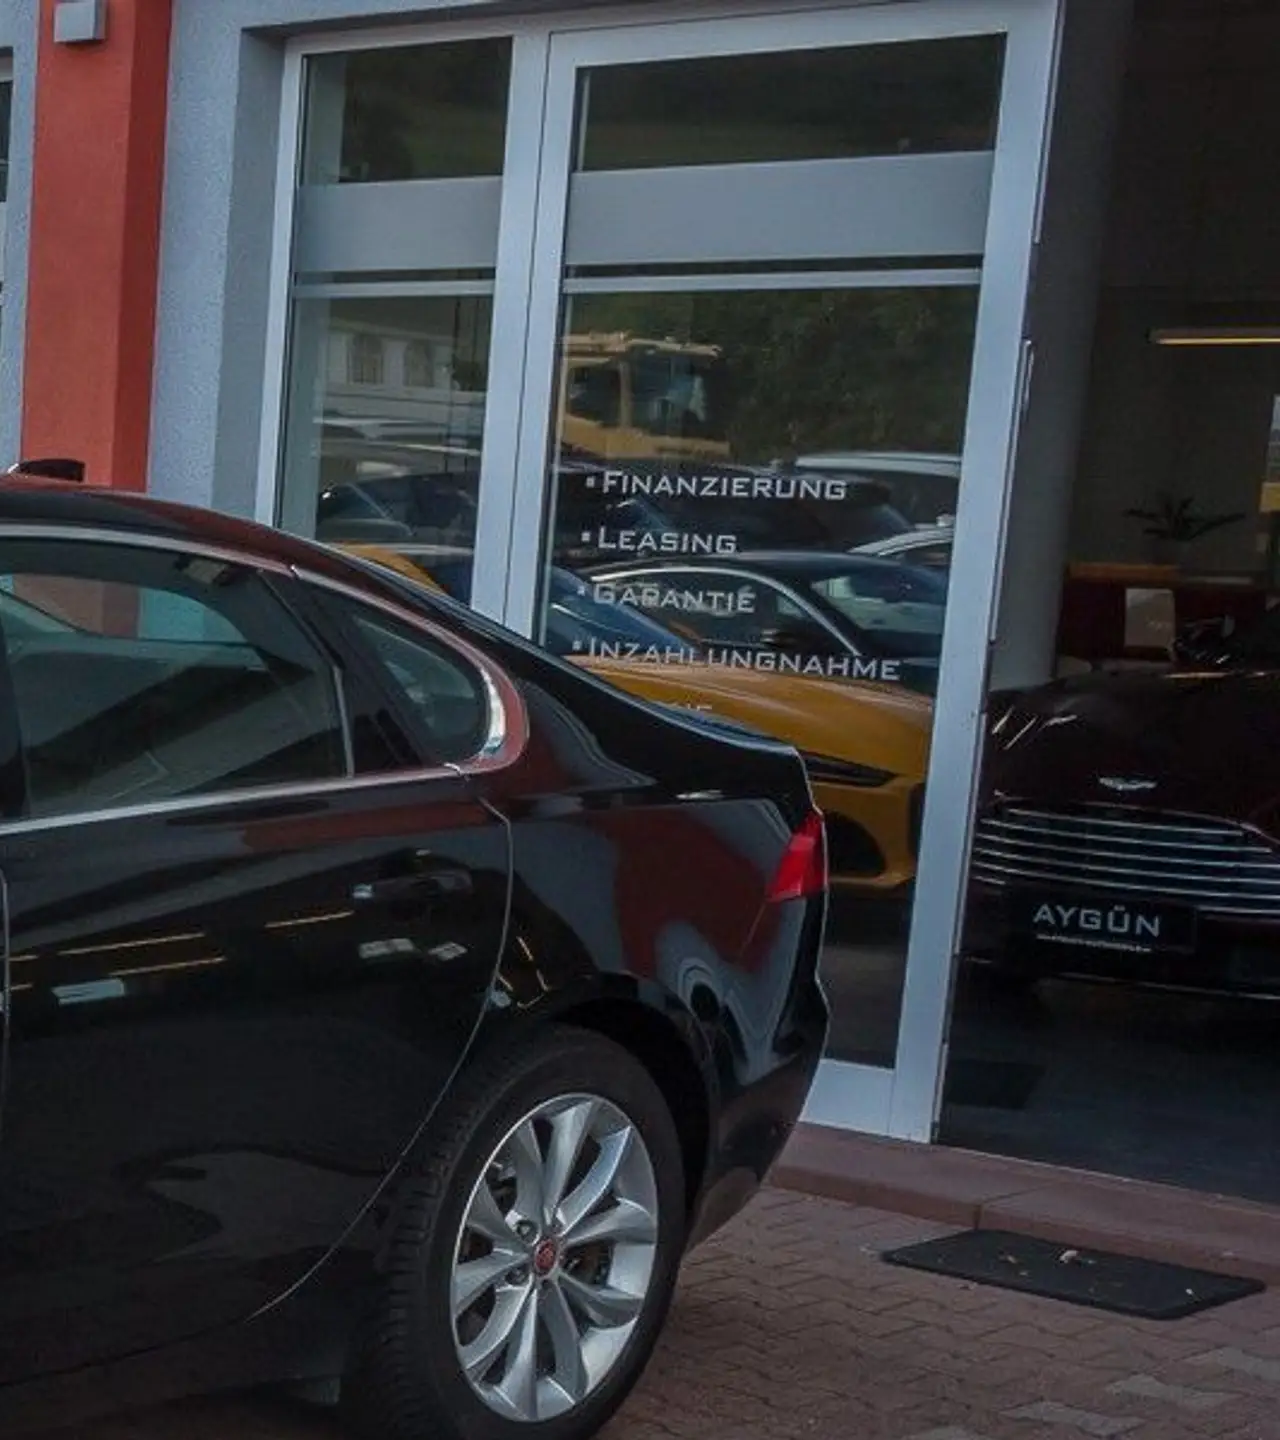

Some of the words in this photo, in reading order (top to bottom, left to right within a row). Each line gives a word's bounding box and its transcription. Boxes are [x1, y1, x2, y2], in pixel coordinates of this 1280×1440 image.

[602, 471, 848, 501] FINANZIERUNG
[597, 526, 738, 554] LEASING
[592, 583, 757, 614] GARANTIE
[589, 637, 901, 682] INZAHLUNGNAHME
[1032, 903, 1161, 938] AYGÜN
